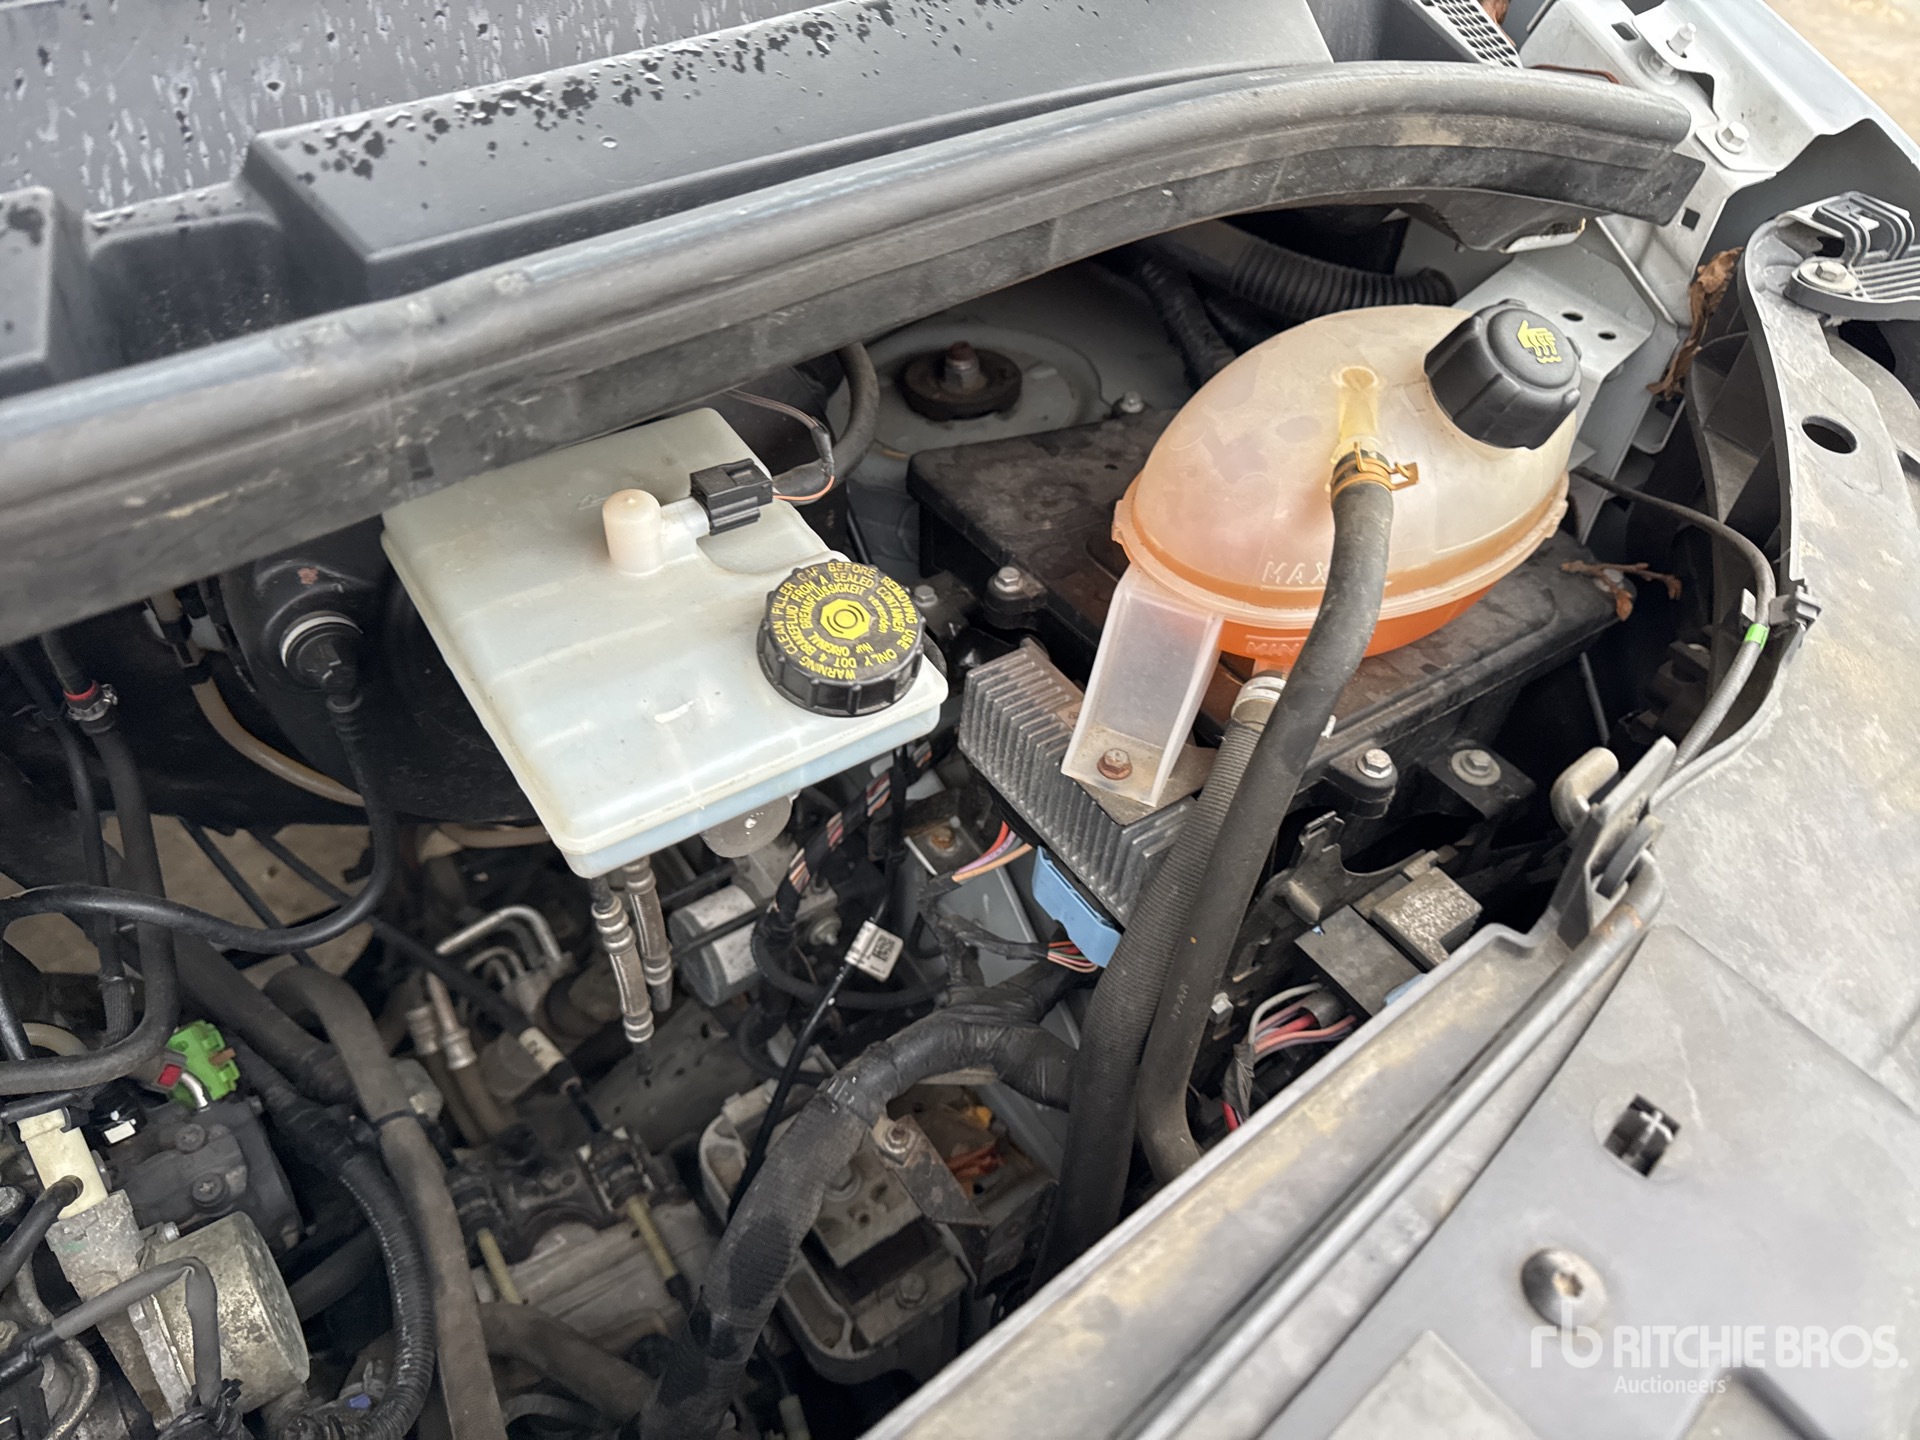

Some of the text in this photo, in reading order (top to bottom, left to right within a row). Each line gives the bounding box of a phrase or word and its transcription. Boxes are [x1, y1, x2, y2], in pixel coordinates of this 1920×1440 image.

[828, 562, 877, 578] BEFORE
[772, 582, 796, 615] FILLER
[880, 576, 918, 624] REMOVING
[785, 574, 905, 668] DOT 4 BRAKEFLUID FROM A SEALED CONTAINER
[777, 622, 798, 654] CLEAN
[808, 632, 850, 656] ORIGINAL
[856, 642, 874, 654] Nur
[897, 630, 917, 650] USE
[799, 656, 856, 679] WARNING
[864, 649, 897, 667] ONLY
